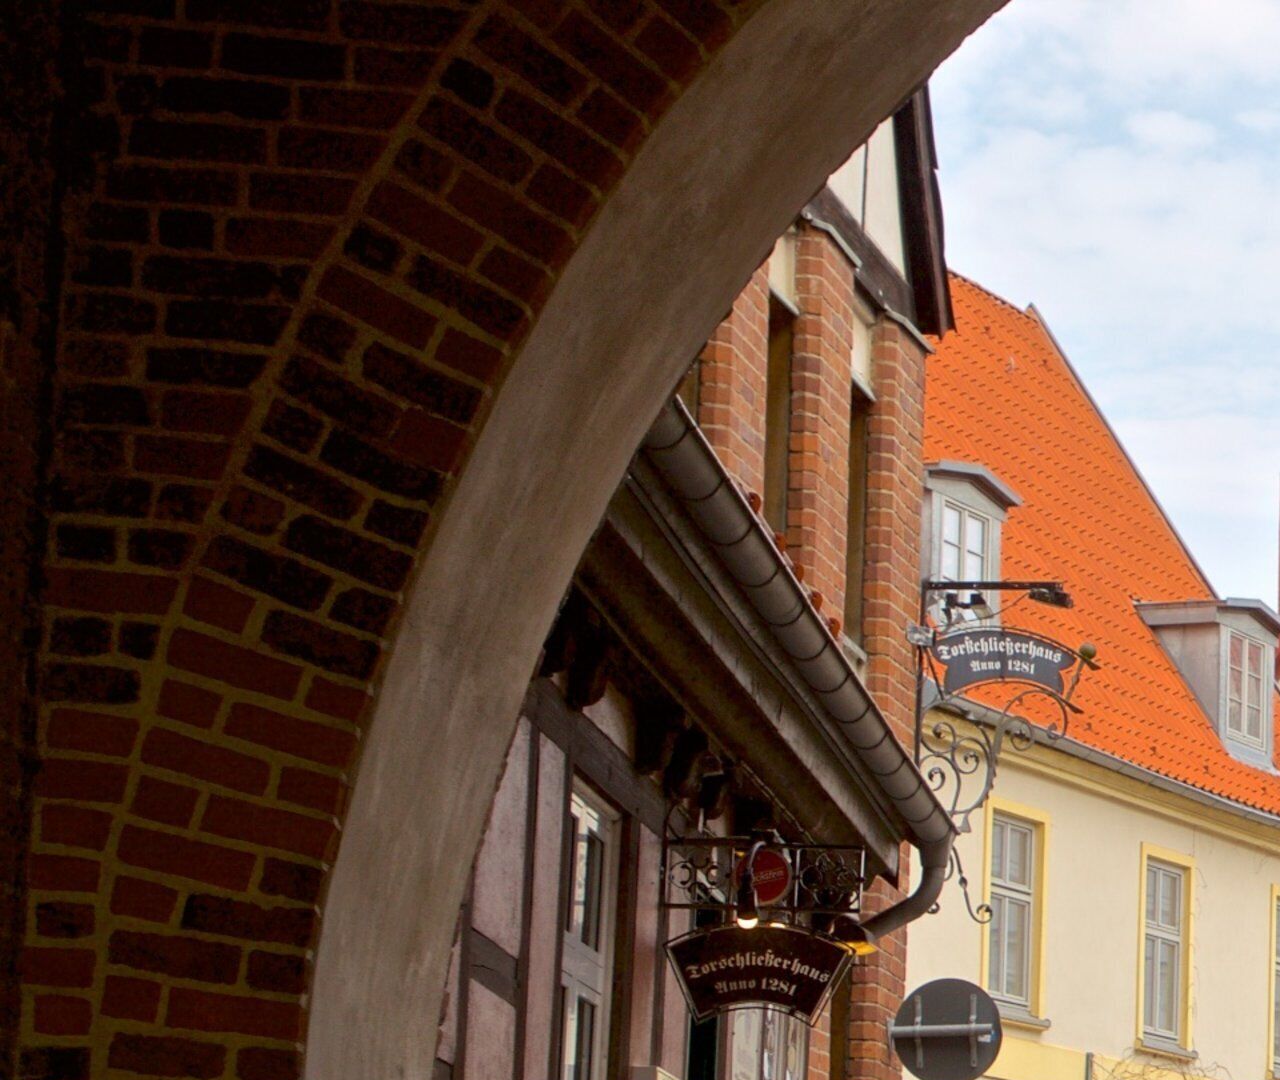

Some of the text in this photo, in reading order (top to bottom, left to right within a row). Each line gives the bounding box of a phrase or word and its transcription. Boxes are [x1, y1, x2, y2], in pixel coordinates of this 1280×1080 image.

[970, 658, 1035, 675] Anno 1281
[714, 977, 798, 997] Anno 1281
